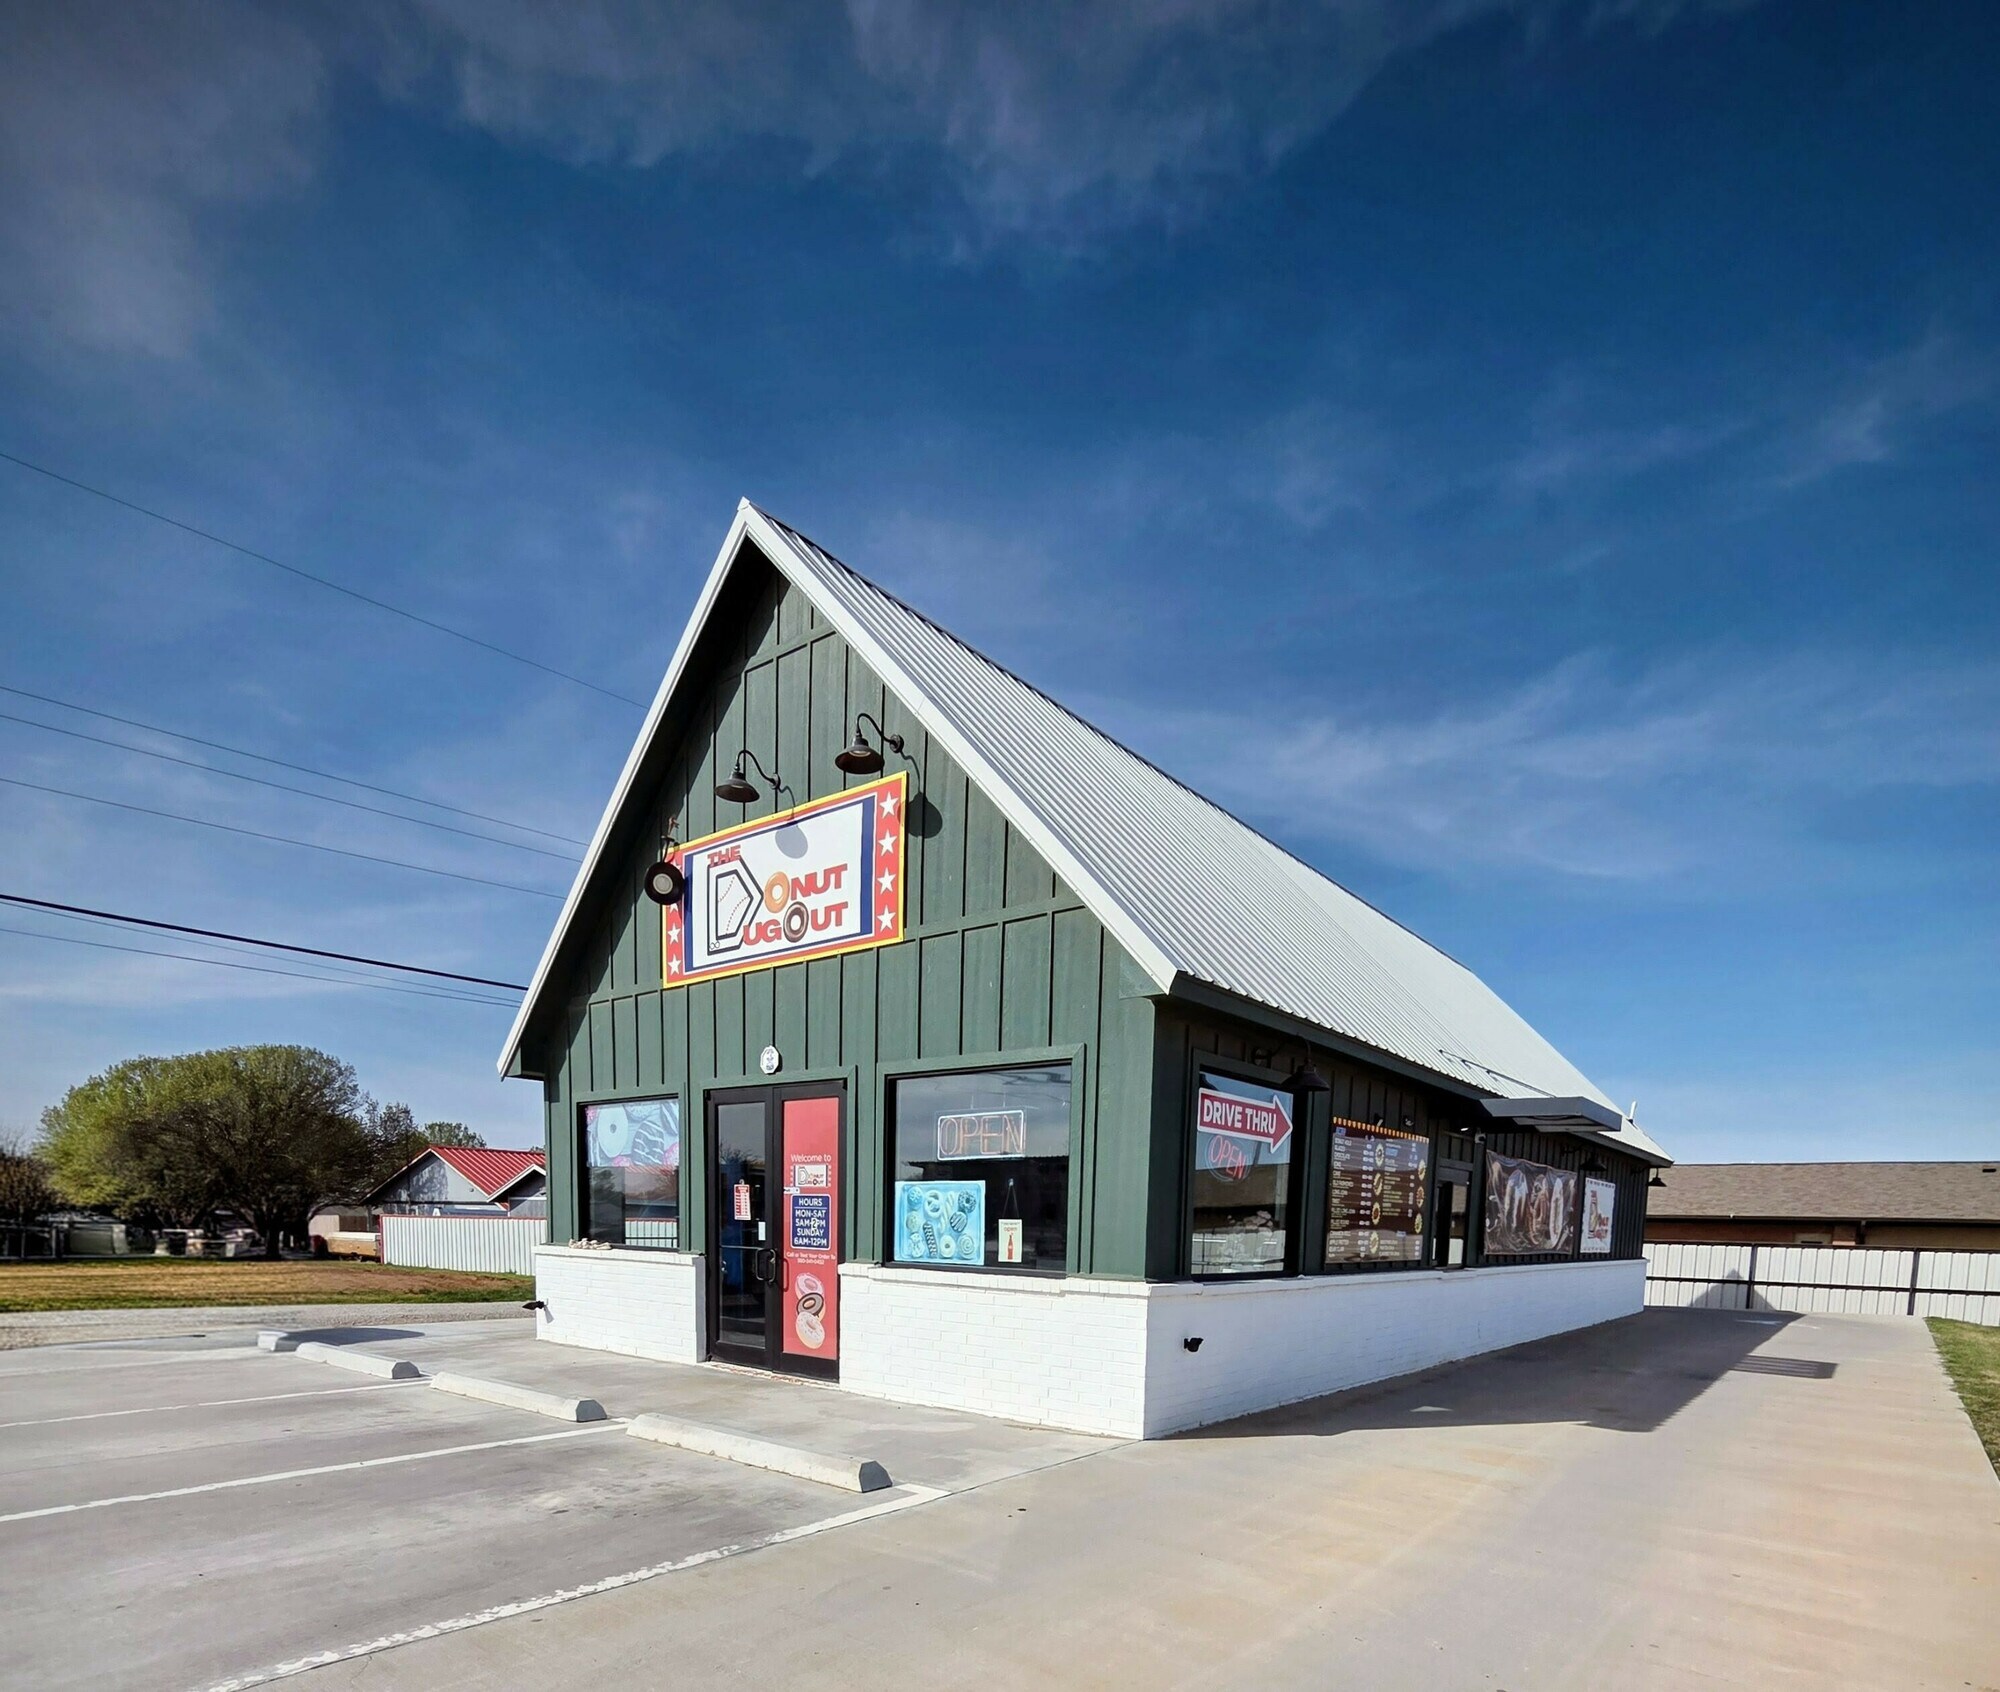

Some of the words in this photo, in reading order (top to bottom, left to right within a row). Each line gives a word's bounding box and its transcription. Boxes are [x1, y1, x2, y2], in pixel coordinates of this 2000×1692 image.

[707, 845, 741, 868] THE
[1203, 1099, 1243, 1129] DRIVE
[1245, 1107, 1277, 1134] THRU
[940, 1114, 1026, 1156] OPEN
[791, 1154, 822, 1163] Welcome
[824, 1154, 832, 1162] to
[1208, 1134, 1247, 1180] OPEN
[798, 1198, 823, 1206] HOURS
[795, 1210, 826, 1218] MON-SAT
[795, 1217, 826, 1228] 5AM-2PM
[797, 1228, 824, 1236] SUNDAY
[794, 1237, 827, 1246] 6AM-12PM
